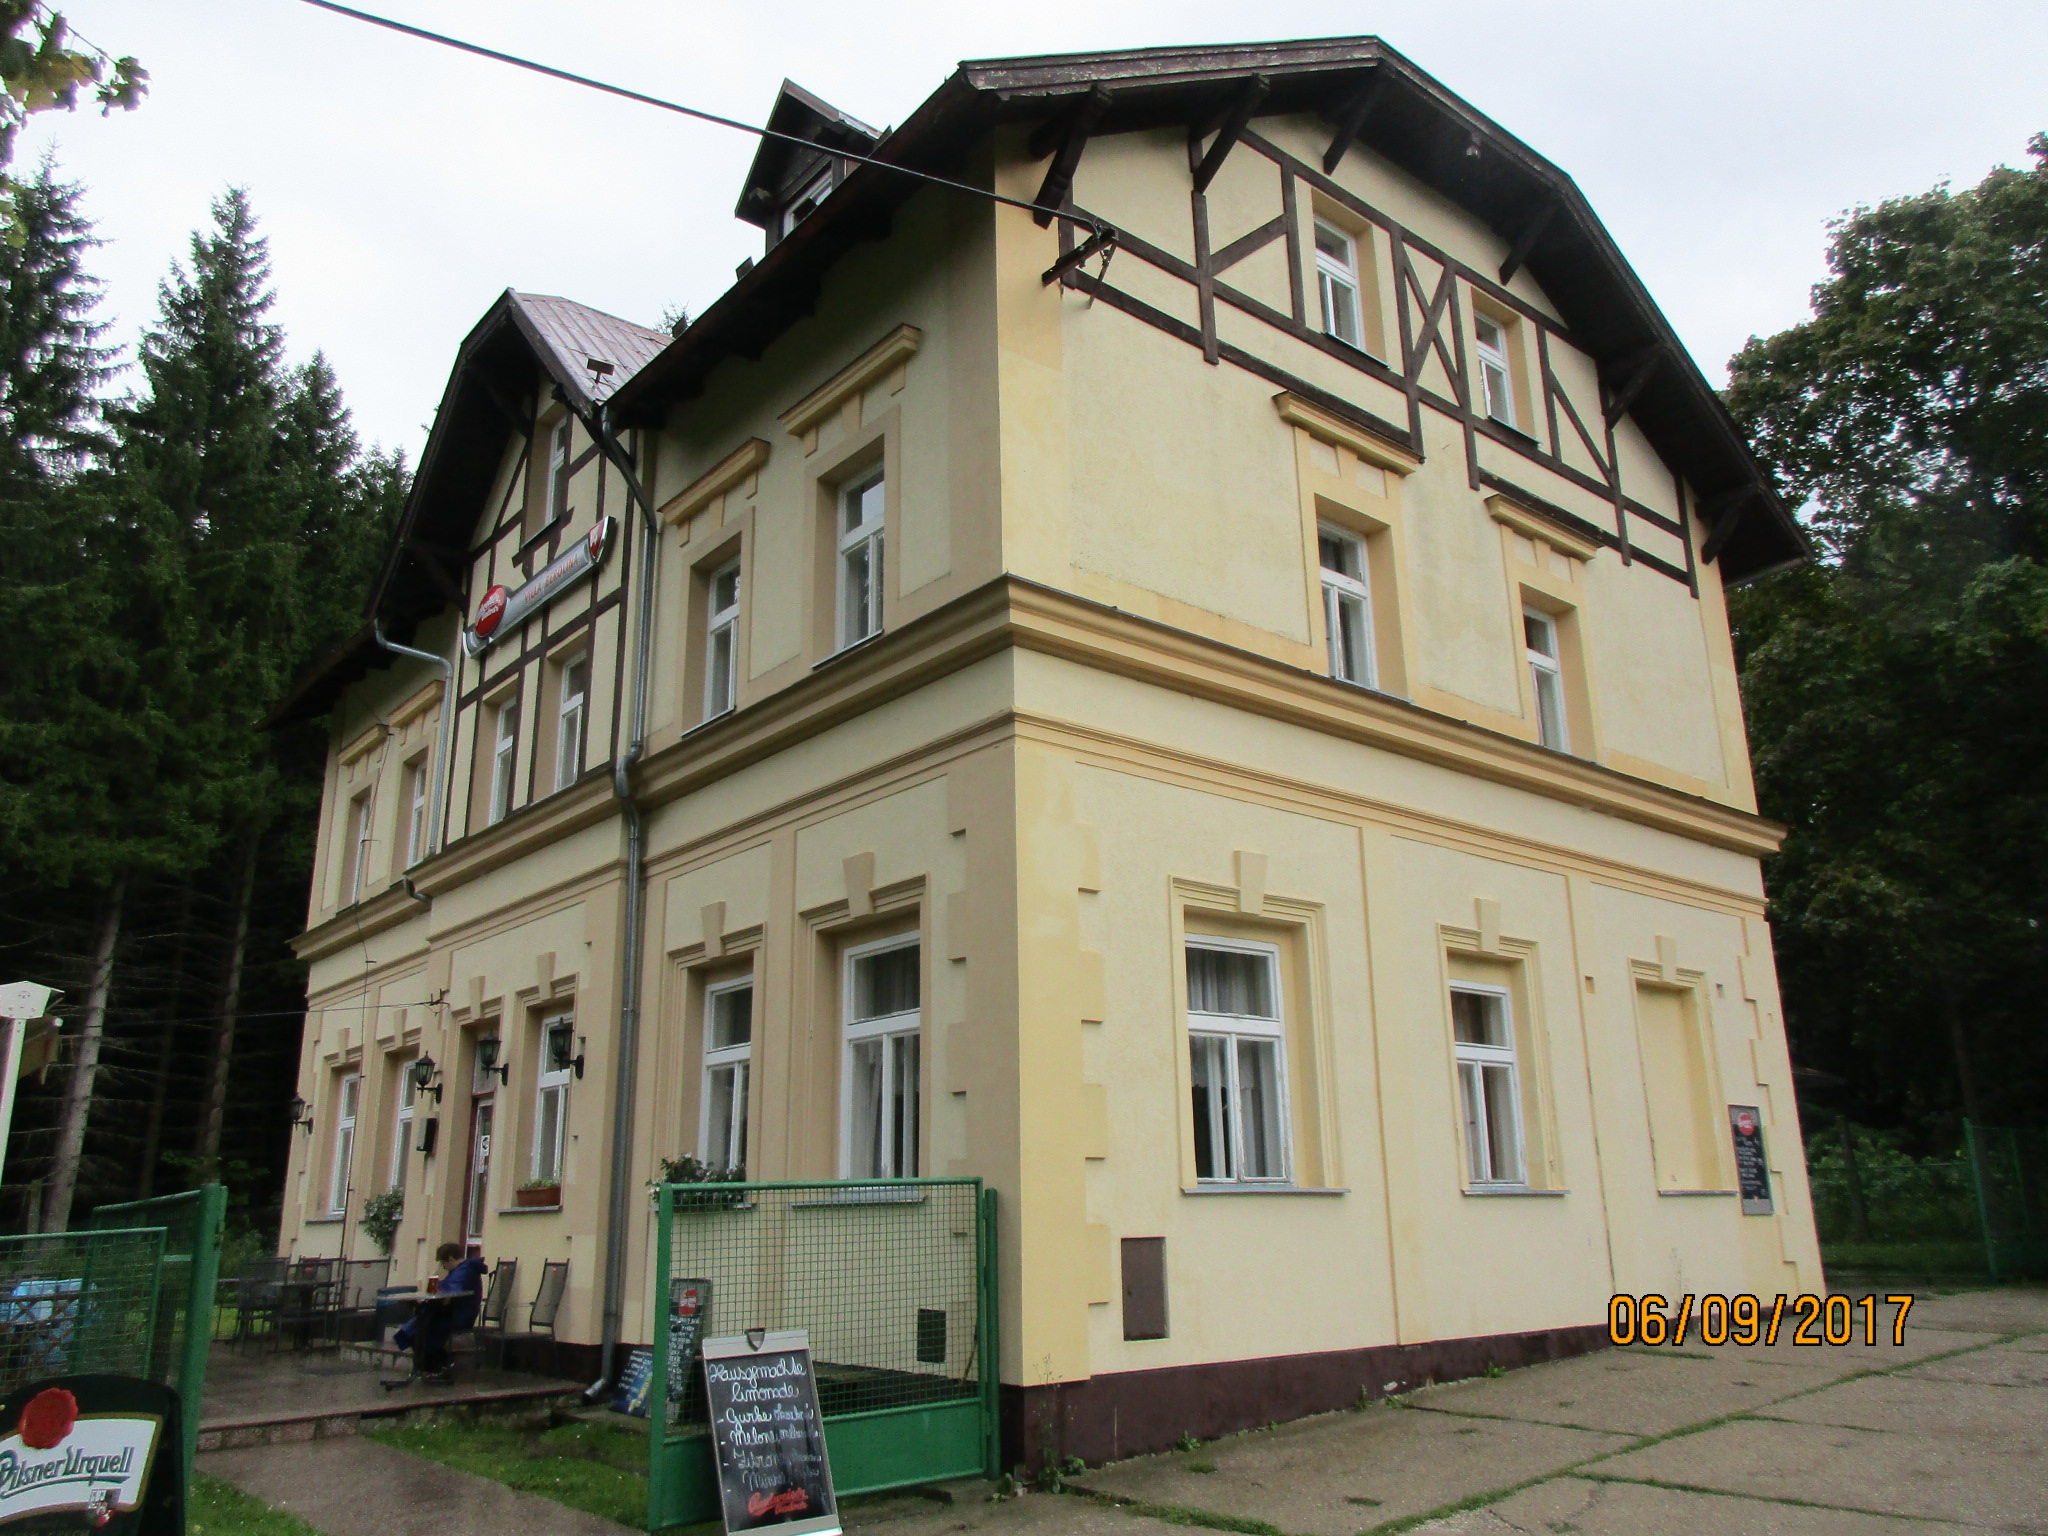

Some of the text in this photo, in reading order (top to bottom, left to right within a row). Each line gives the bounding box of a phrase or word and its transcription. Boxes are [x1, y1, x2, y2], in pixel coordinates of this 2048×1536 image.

[524, 554, 579, 603] VILLA BEROLINA
[0, 1446, 136, 1492] Pilsner Urquell
